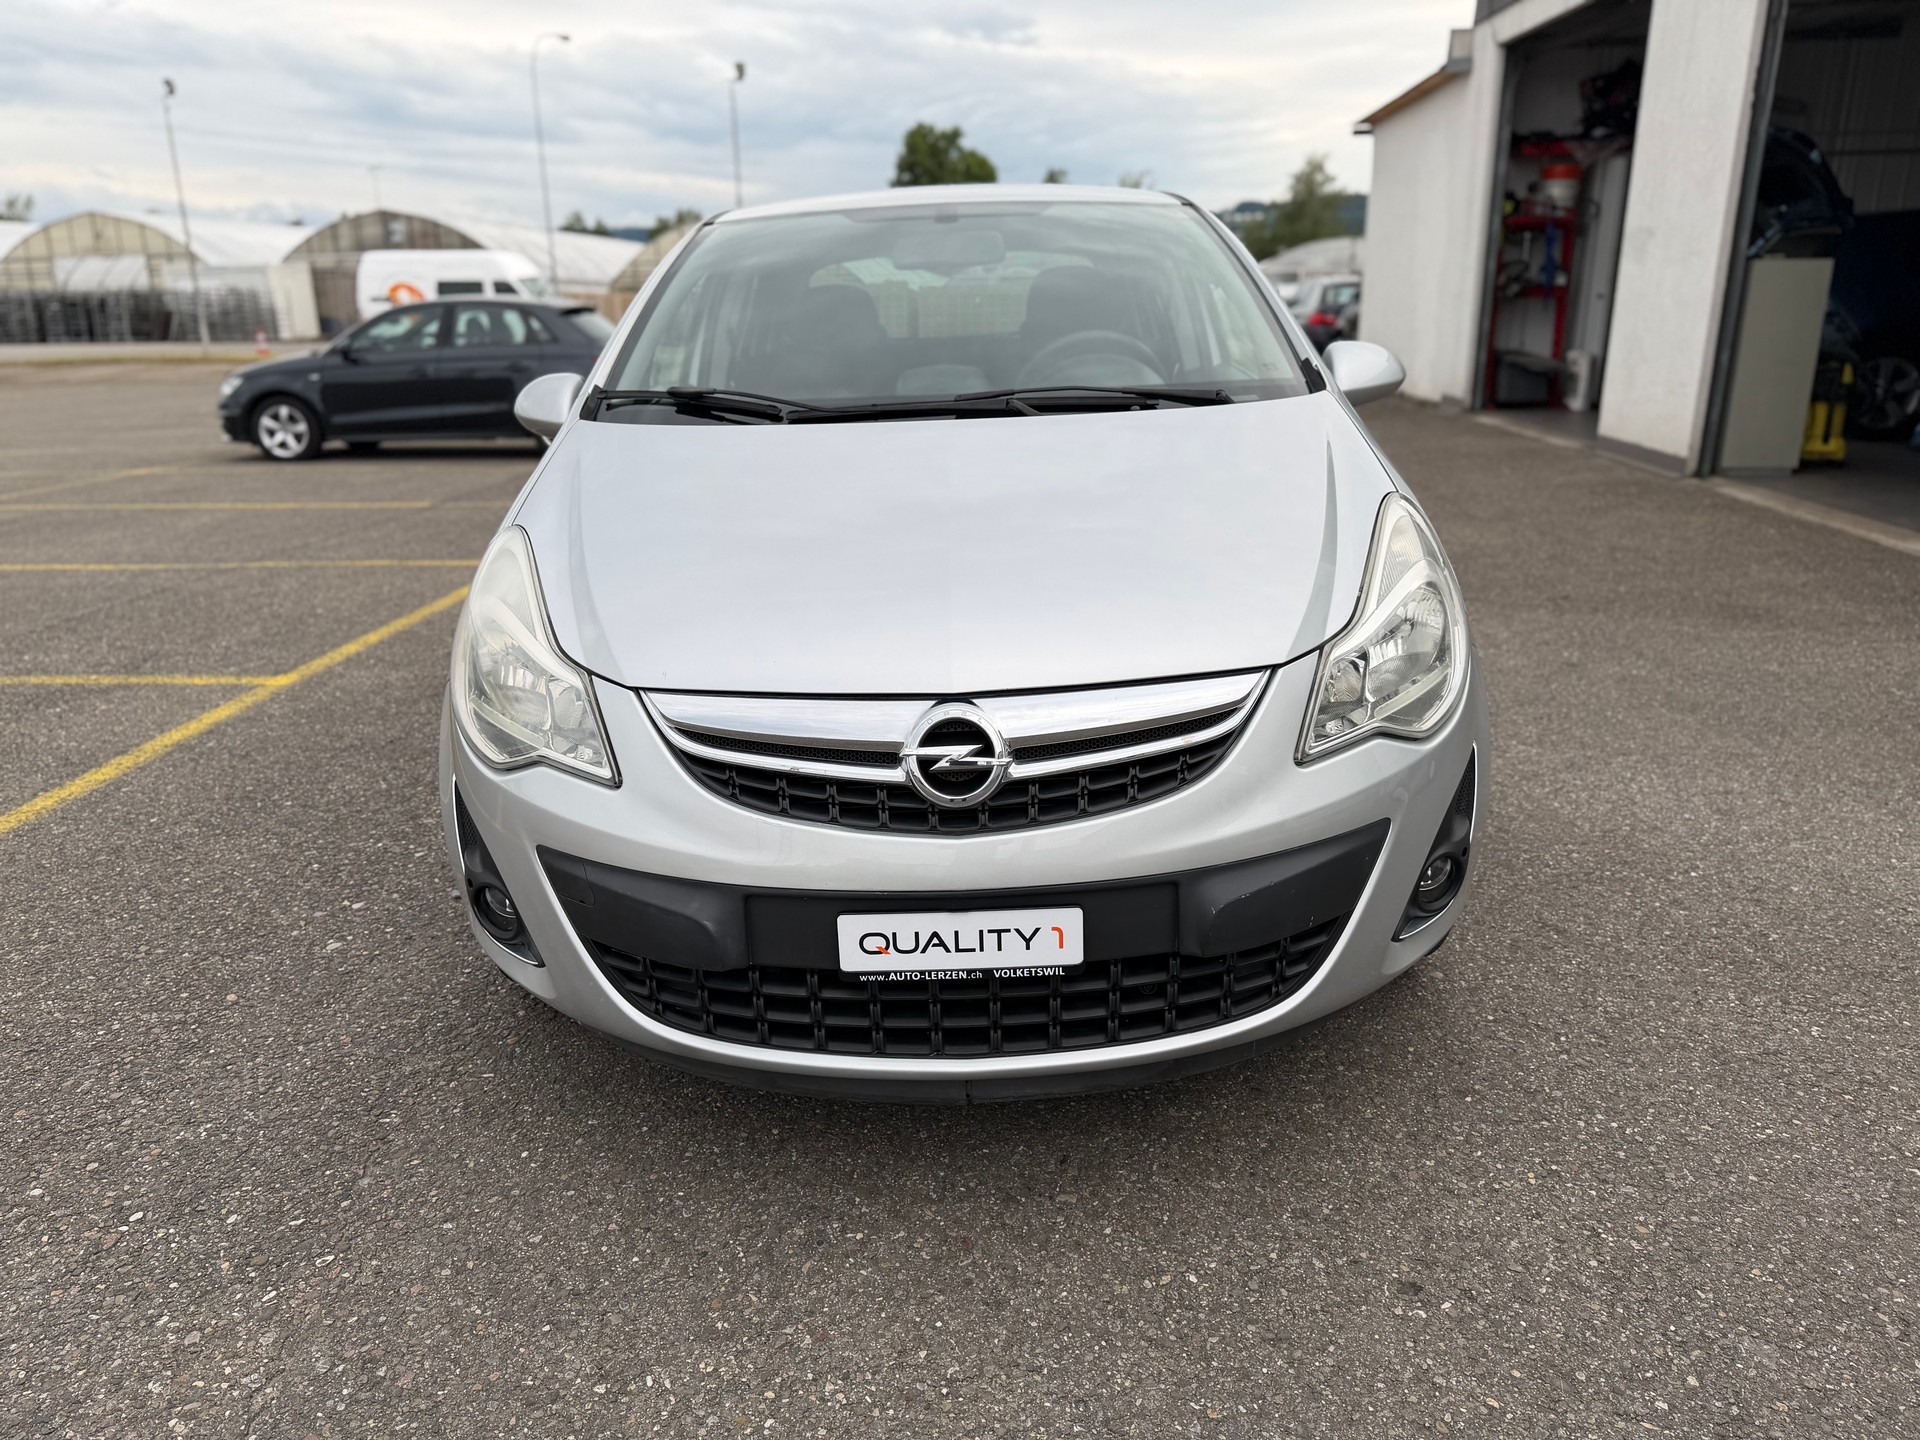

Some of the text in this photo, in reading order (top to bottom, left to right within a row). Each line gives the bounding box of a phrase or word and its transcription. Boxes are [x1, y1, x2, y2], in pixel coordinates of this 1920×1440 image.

[859, 926, 1064, 955] QUALITY 1
[859, 967, 1066, 981] www.AUTO-LERZEN.ch VOLKETSWIL
